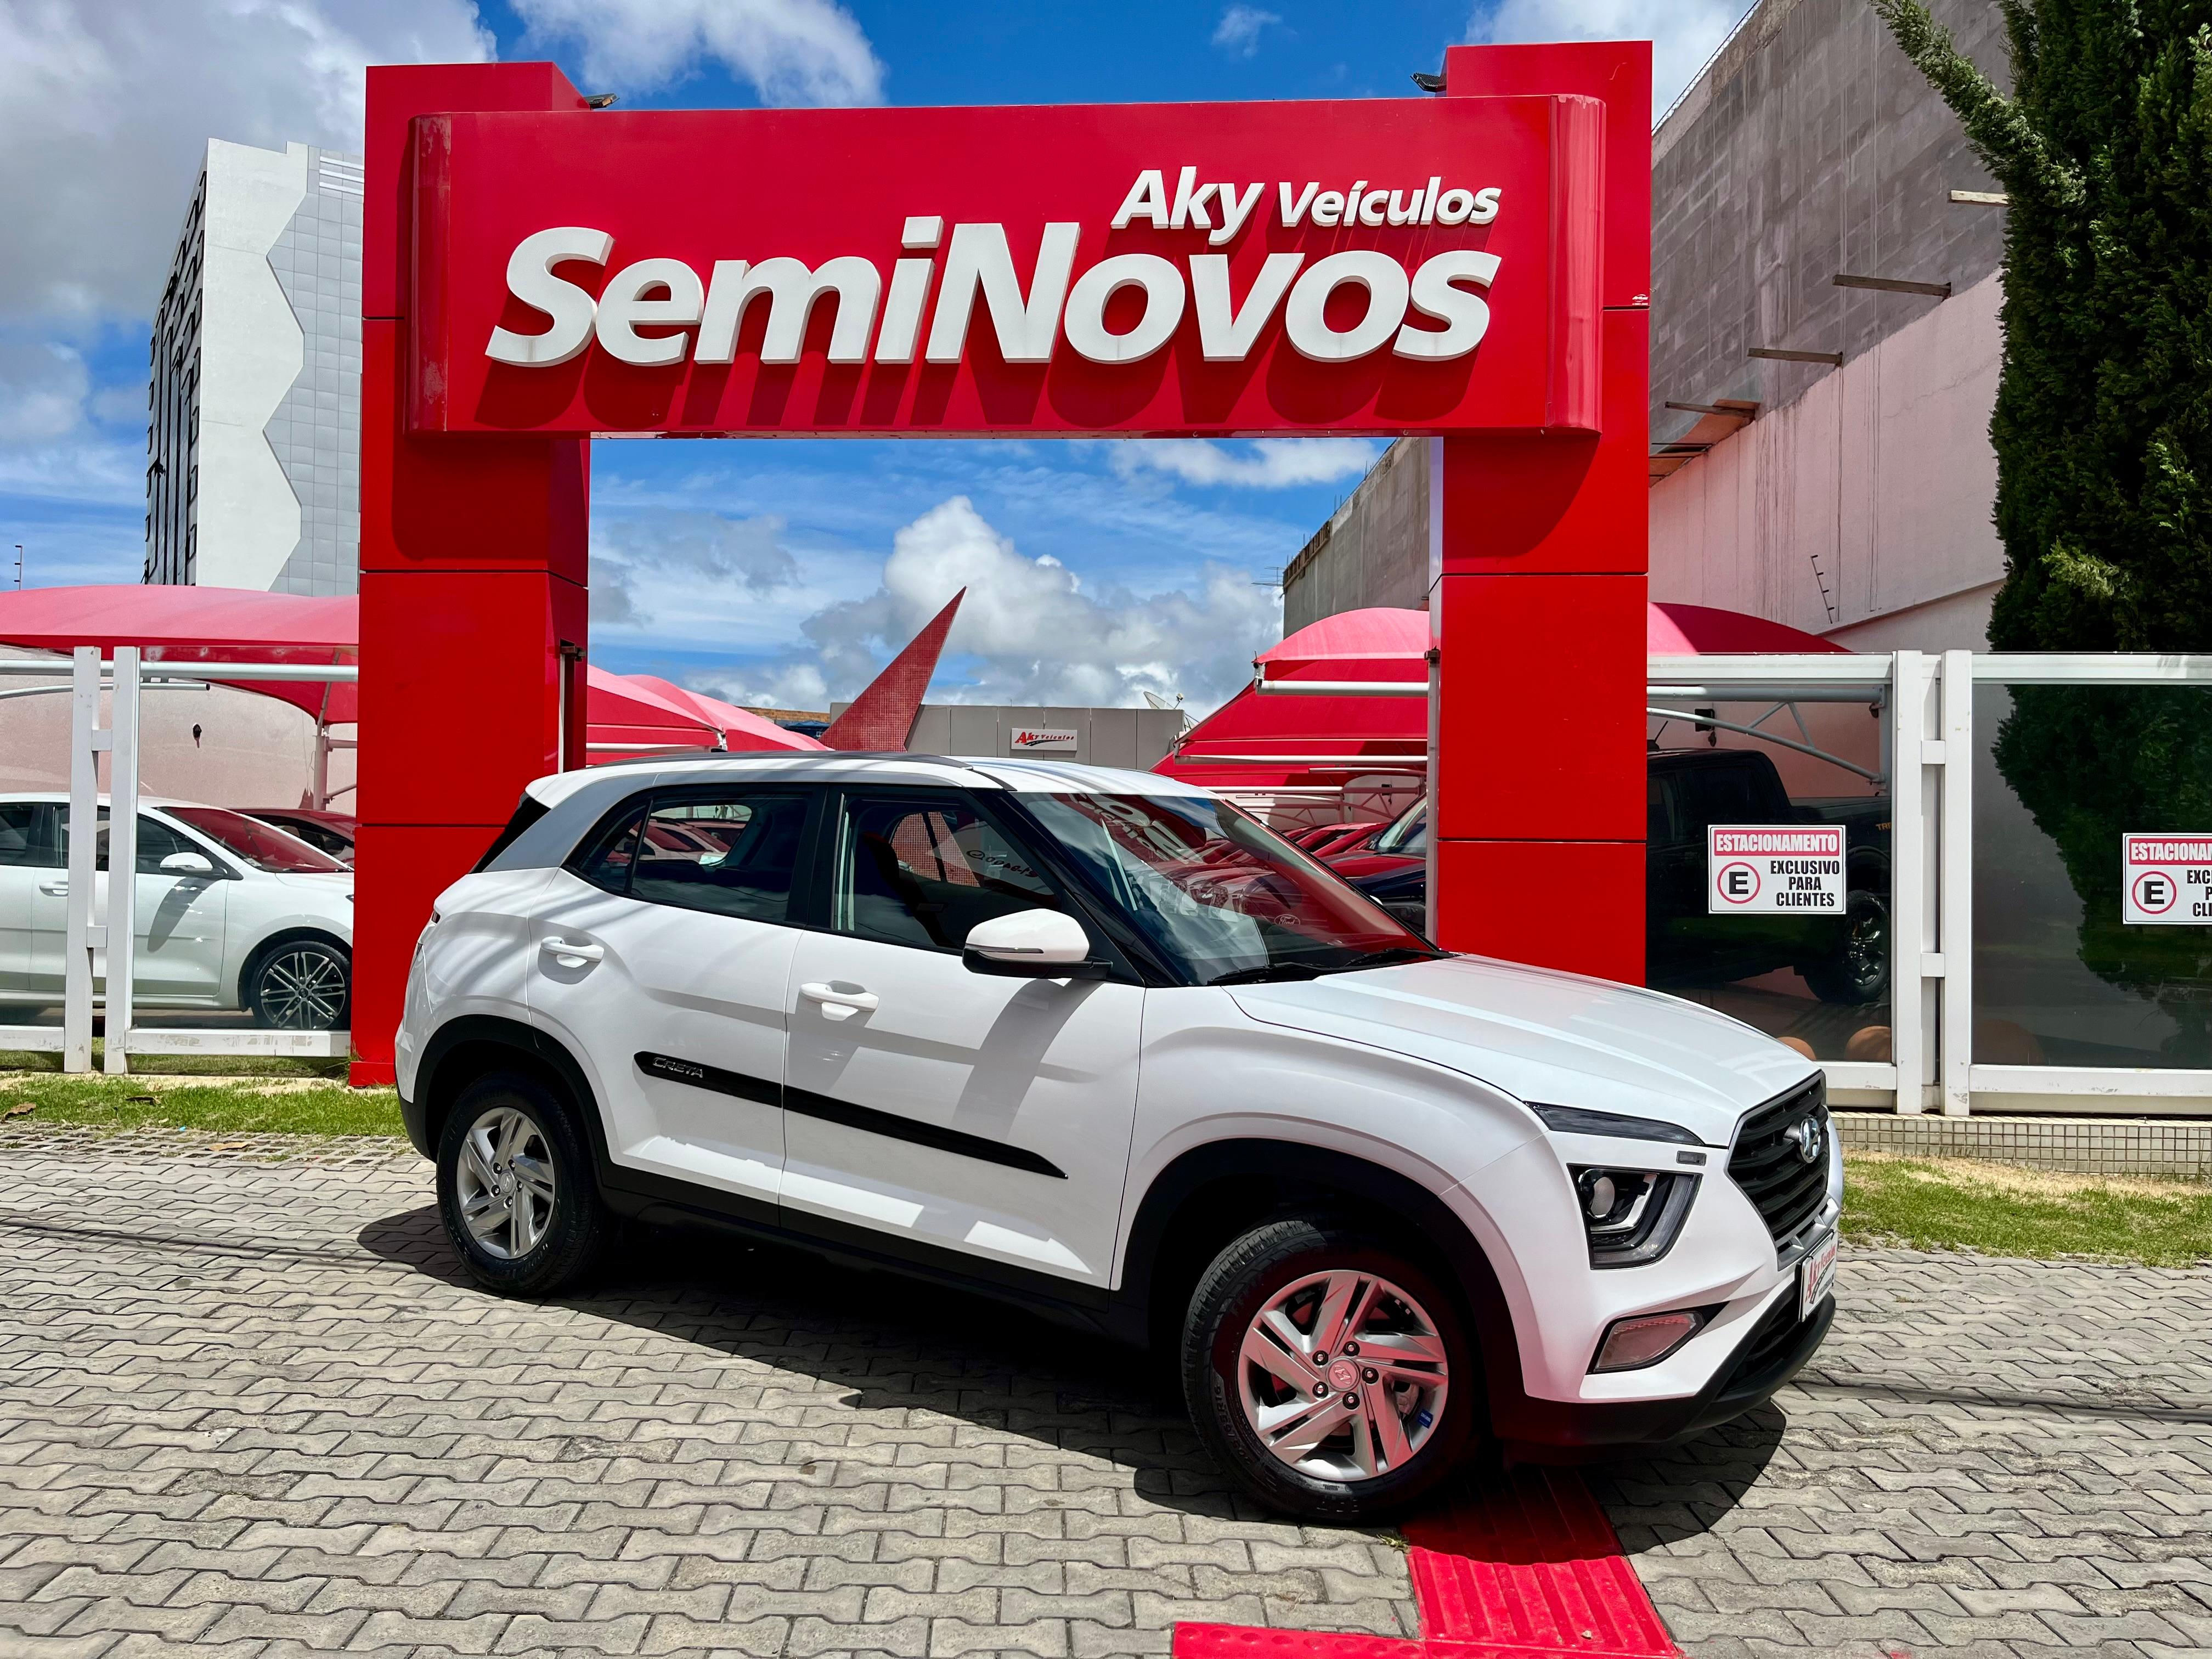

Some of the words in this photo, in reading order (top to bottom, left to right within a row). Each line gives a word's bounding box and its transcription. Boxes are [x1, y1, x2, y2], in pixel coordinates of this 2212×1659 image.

[1110, 166, 1265, 245] Aky
[1279, 176, 1502, 227] Veículos
[485, 215, 1502, 368] SemiNovos
[1014, 731, 1039, 743] Aky
[1716, 833, 1838, 853] ESTACIONAMENTO
[1770, 860, 1840, 874] EXCLUSIVO
[1729, 872, 1749, 895] E
[1788, 876, 1822, 890] PARA
[2143, 881, 2165, 905] E
[1776, 893, 1835, 906] CLIENTES
[652, 1057, 704, 1079] CRETA
